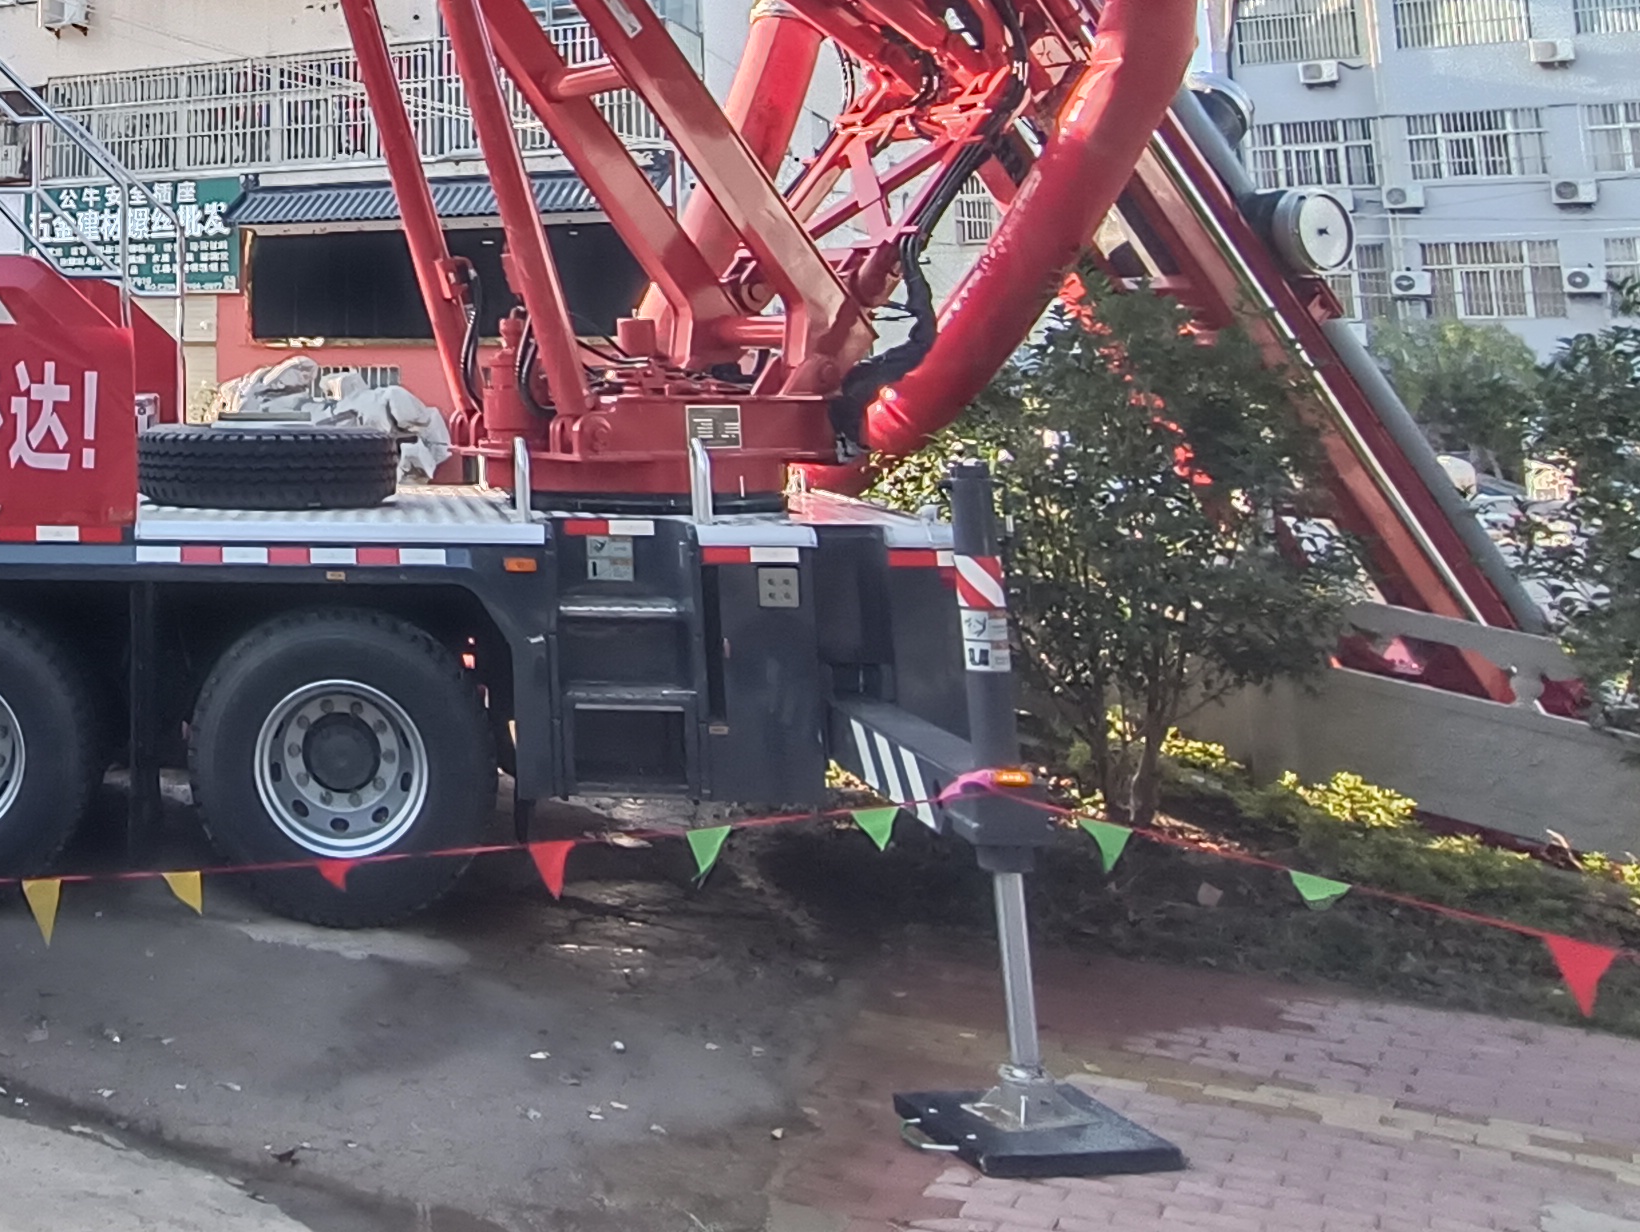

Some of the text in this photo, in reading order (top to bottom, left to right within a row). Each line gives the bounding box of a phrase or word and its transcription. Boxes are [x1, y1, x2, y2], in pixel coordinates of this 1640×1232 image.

[59, 181, 197, 210] 公牛安全插座
[29, 201, 232, 243] 五金建材螺丝批发
